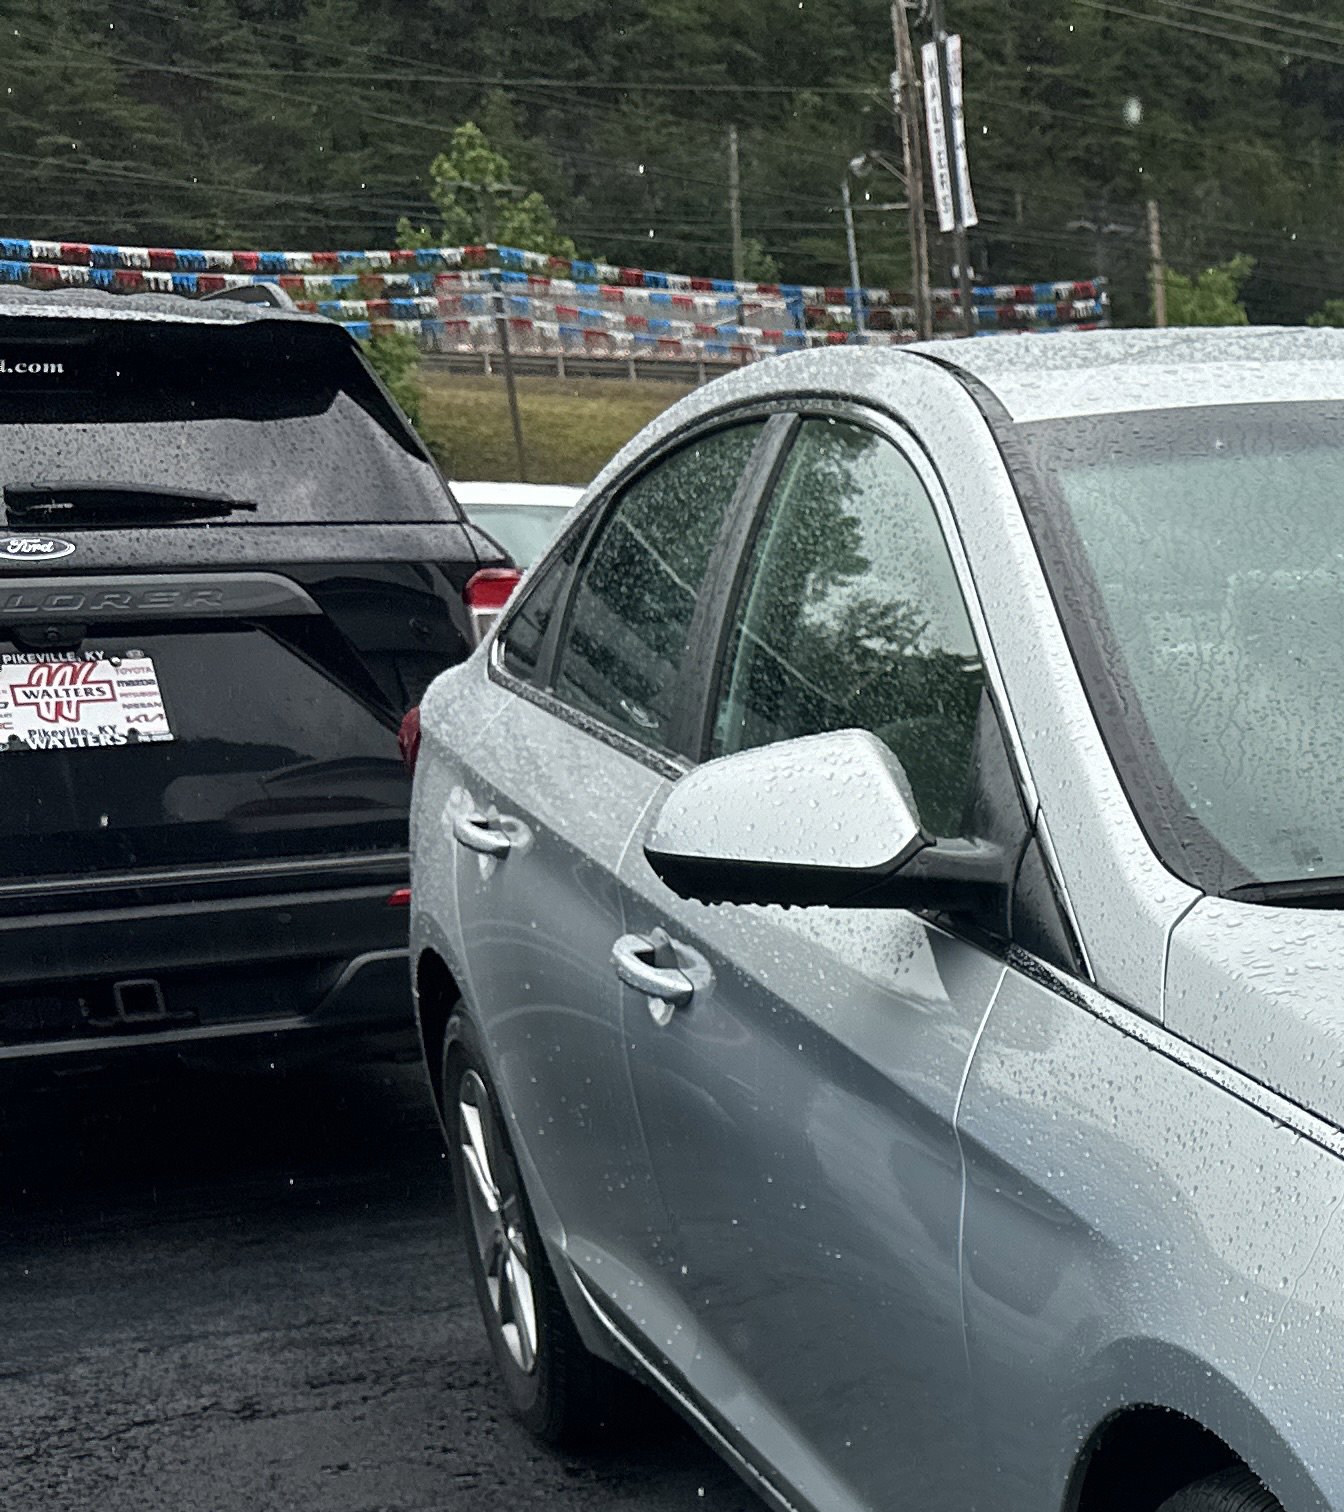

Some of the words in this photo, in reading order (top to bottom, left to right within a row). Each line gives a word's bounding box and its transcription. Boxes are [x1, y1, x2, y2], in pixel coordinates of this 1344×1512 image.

[7, 537, 55, 553] Ford
[85, 650, 105, 661] KY
[115, 666, 154, 675] TOYOTA
[22, 686, 107, 699] WALTERS
[98, 724, 118, 735] KY
[24, 733, 128, 750] WALTERS
